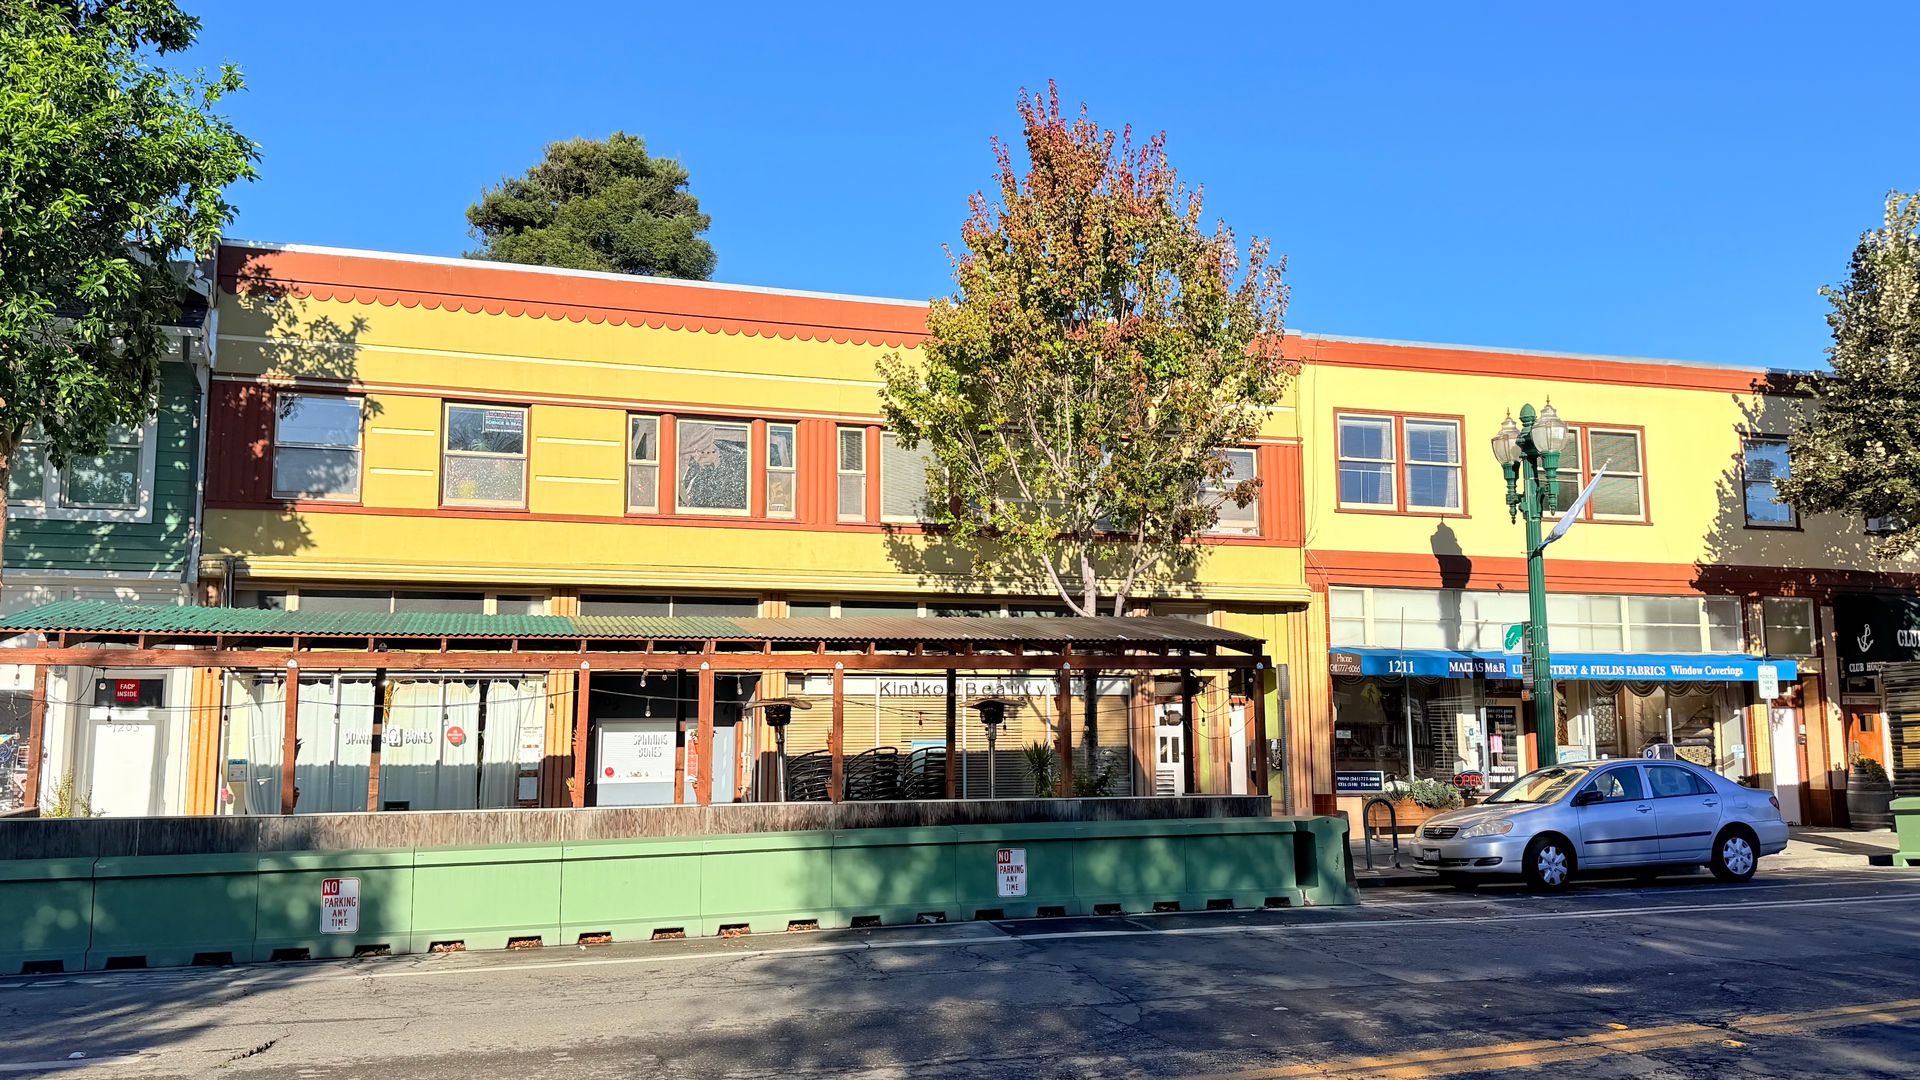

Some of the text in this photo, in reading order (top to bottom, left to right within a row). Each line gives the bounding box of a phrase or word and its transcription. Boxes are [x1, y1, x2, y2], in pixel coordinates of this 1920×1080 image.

[1897, 629, 1920, 647] CLU
[1337, 653, 1352, 662] Phone
[1388, 660, 1415, 673] 1211
[1449, 661, 1483, 673] MACIAS
[1485, 662, 1506, 673] M&R
[1580, 665, 1588, 675] &
[1590, 665, 1624, 675] FIELDS
[1626, 665, 1666, 676] FABRICS
[1671, 665, 1703, 675] Window
[1704, 665, 1744, 677] Coverings
[1849, 663, 1864, 672] CLUB
[879, 682, 1047, 697] Kinuko Beauty
[632, 733, 668, 746] SPINNING
[637, 746, 662, 758] BONES
[1453, 774, 1484, 787] OPEN
[998, 851, 1010, 862] NO
[1000, 864, 1024, 874] PARKING
[324, 881, 338, 894] NO
[1006, 883, 1019, 891] TIME
[324, 896, 357, 907] PARKING
[332, 909, 348, 918] ANY
[331, 919, 348, 927] TIME
